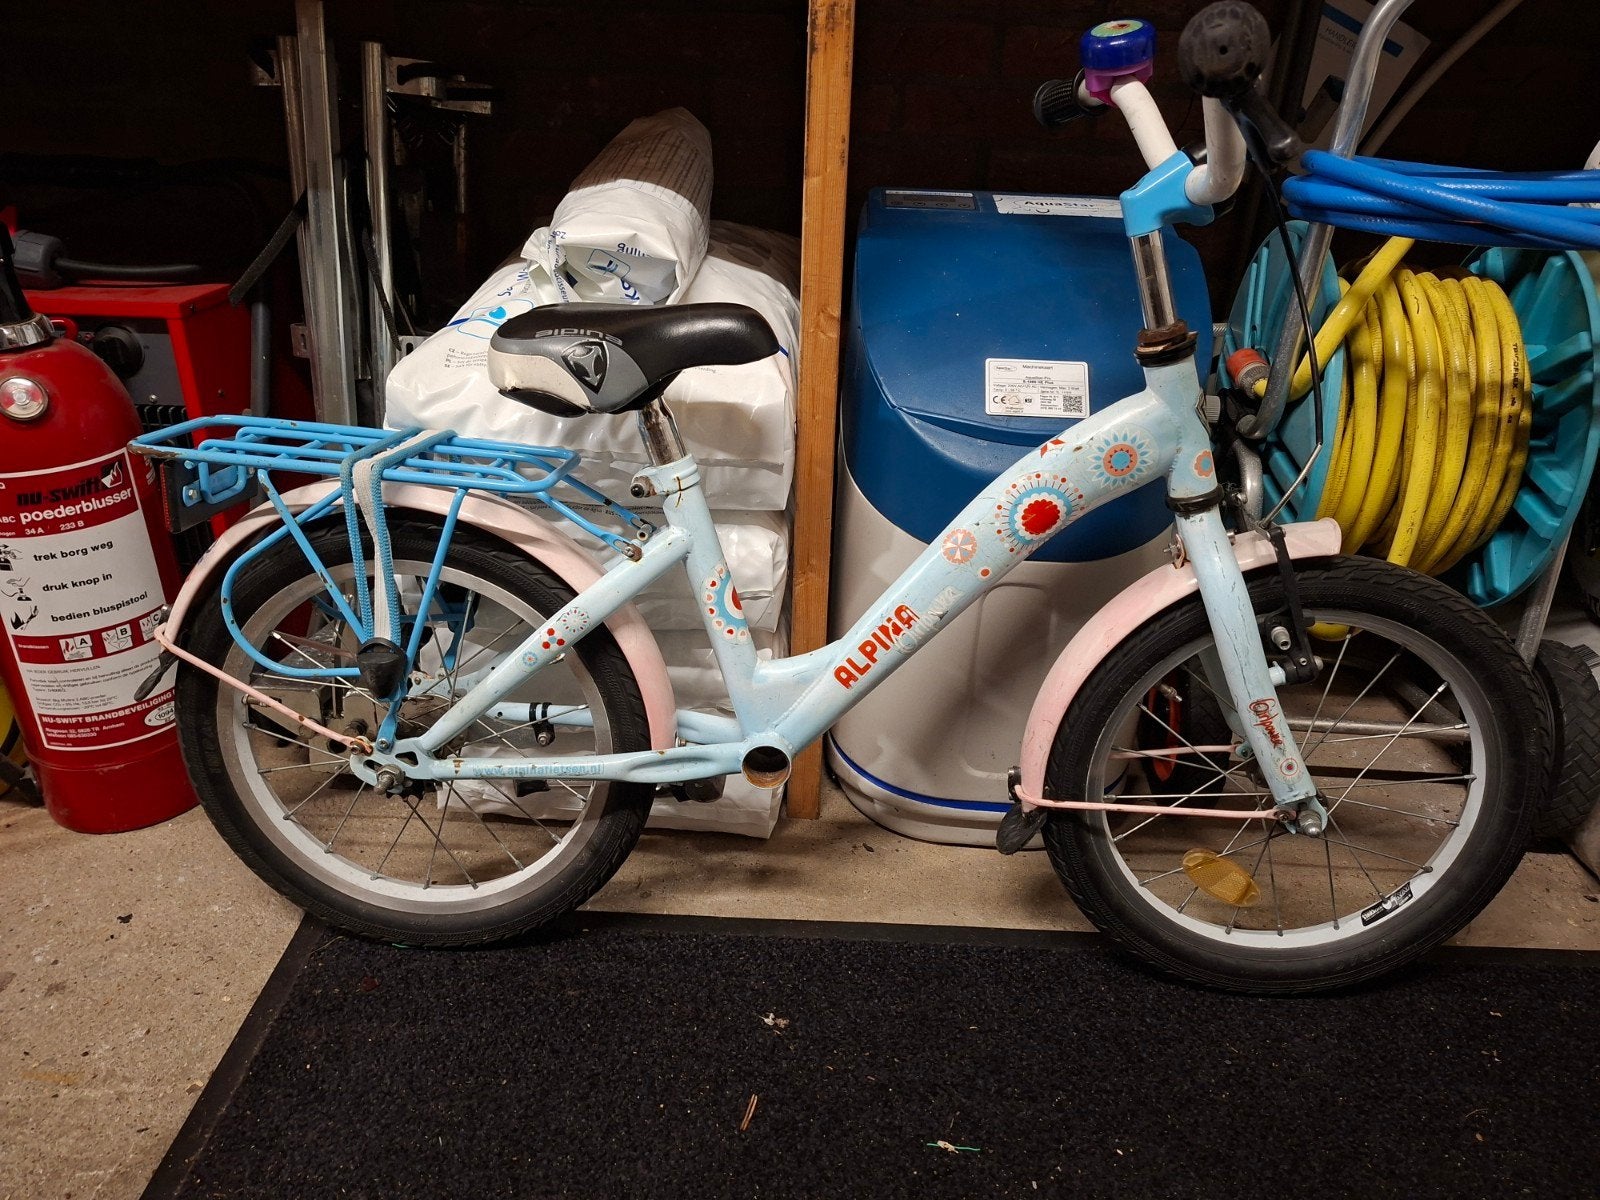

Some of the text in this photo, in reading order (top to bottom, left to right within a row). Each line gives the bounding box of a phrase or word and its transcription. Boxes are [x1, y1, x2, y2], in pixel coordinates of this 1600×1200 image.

[19, 488, 132, 525] poederblusser
[59, 521, 75, 531] 233
[33, 540, 114, 562] trek borg weg
[42, 572, 113, 592] druk knop in
[51, 591, 148, 622] bedien bluspistool
[79, 613, 160, 646] A B C
[833, 604, 920, 690] ALPINA
[42, 715, 83, 725] NU-SWIFT
[85, 693, 172, 723] BRANDBEVEILIGING
[158, 707, 174, 719] 1094
